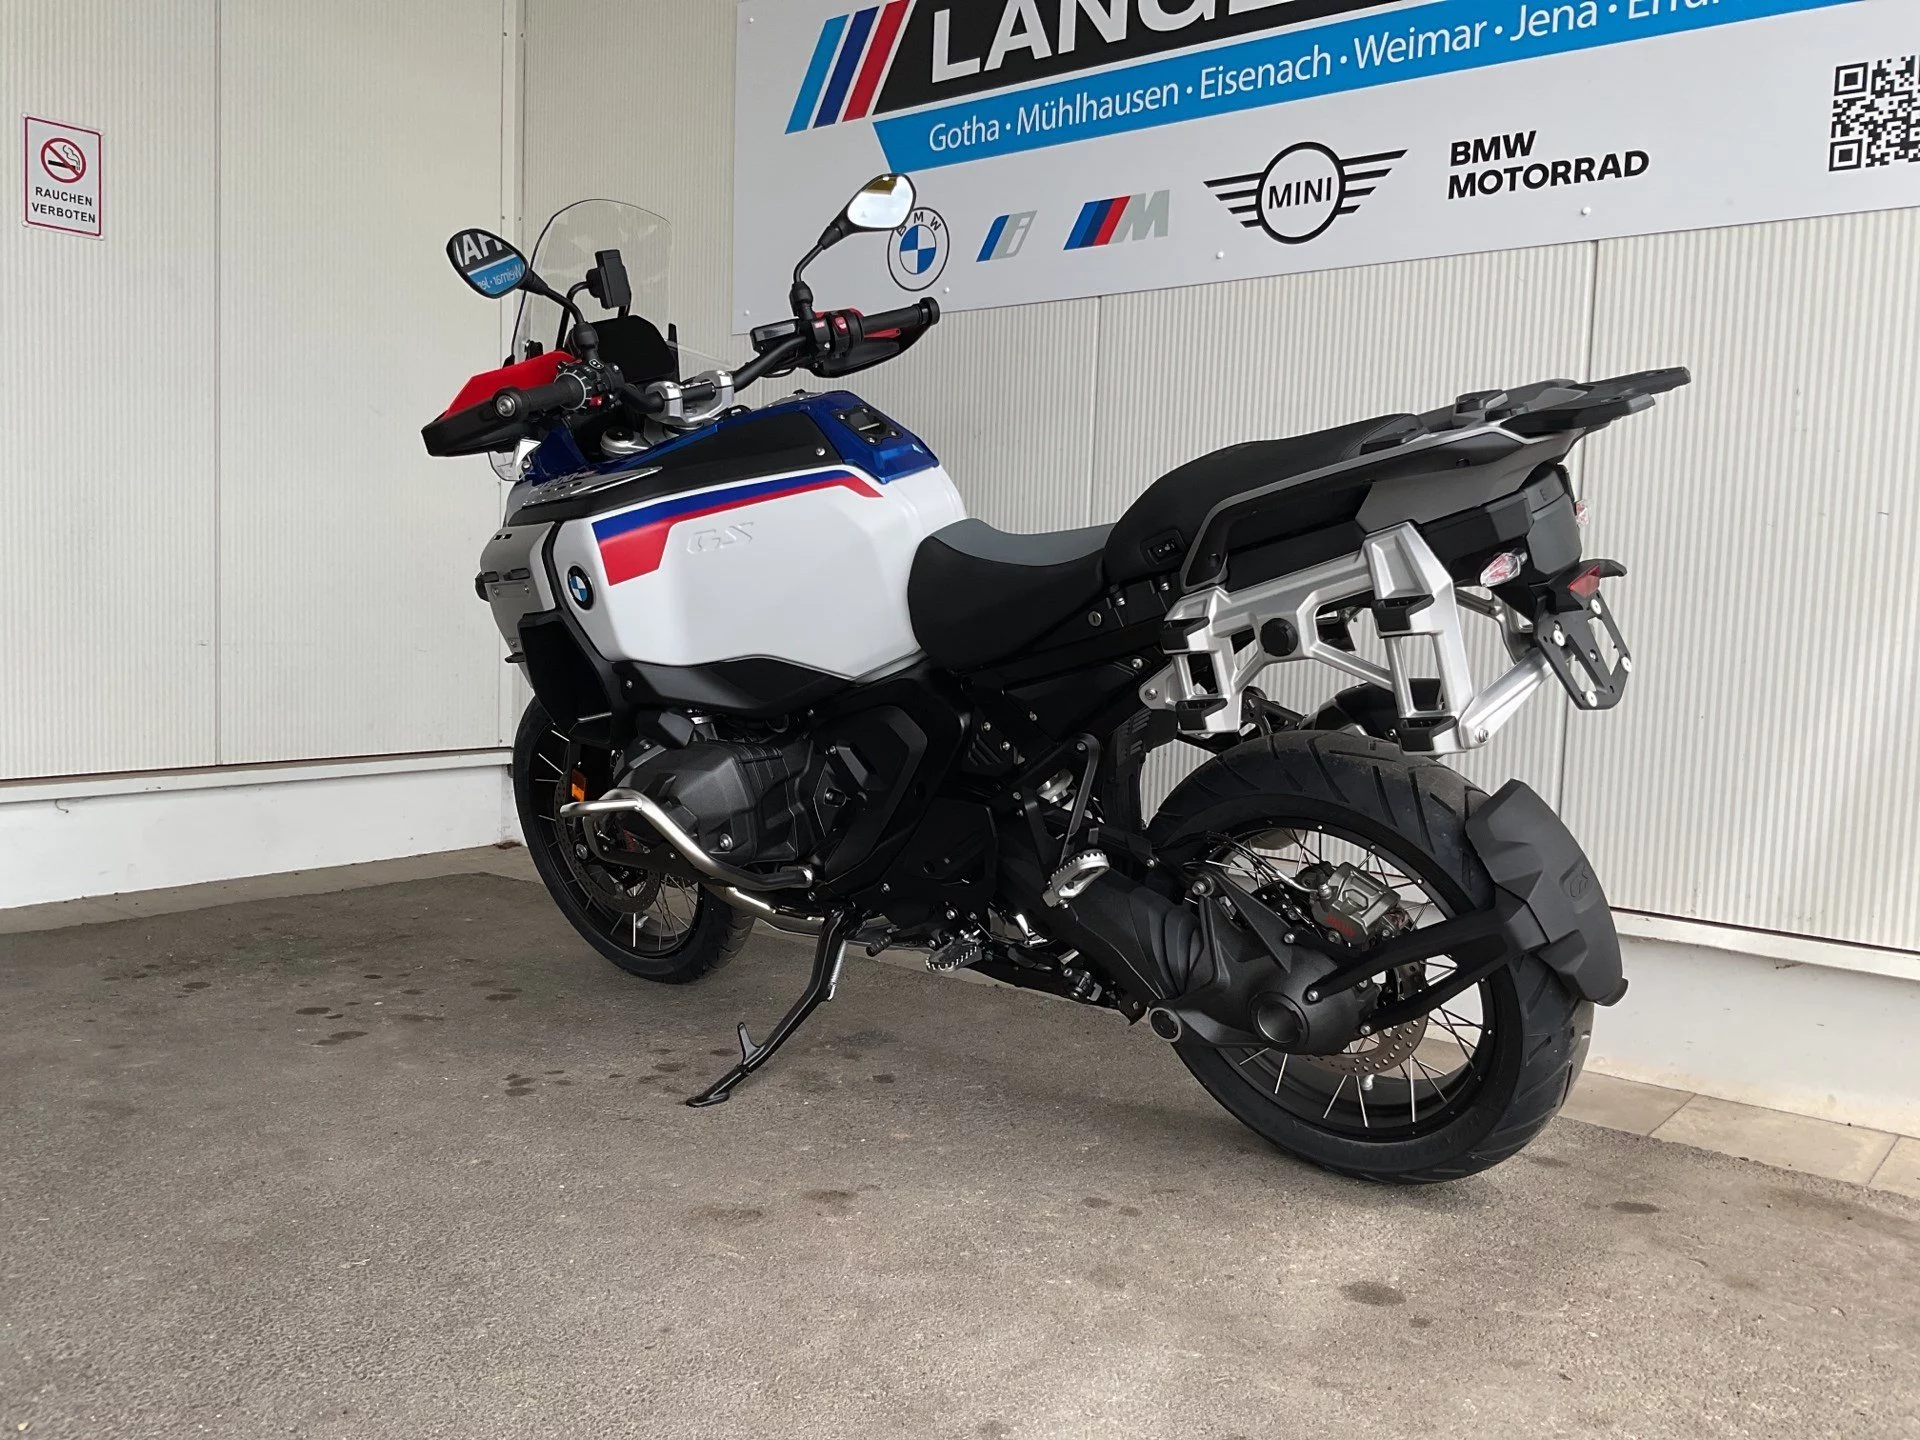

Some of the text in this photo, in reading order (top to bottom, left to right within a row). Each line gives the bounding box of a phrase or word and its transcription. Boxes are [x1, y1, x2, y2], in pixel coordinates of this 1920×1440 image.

[929, 0, 1598, 151] Gotha Mühlhausen Eisenach Weimar Jena
[1450, 130, 1537, 167] BMW
[1448, 150, 1650, 200] MOTORRAD
[35, 186, 93, 207] RAUCHEN
[1268, 176, 1332, 210] MINI
[31, 202, 96, 224] VERBOTEN
